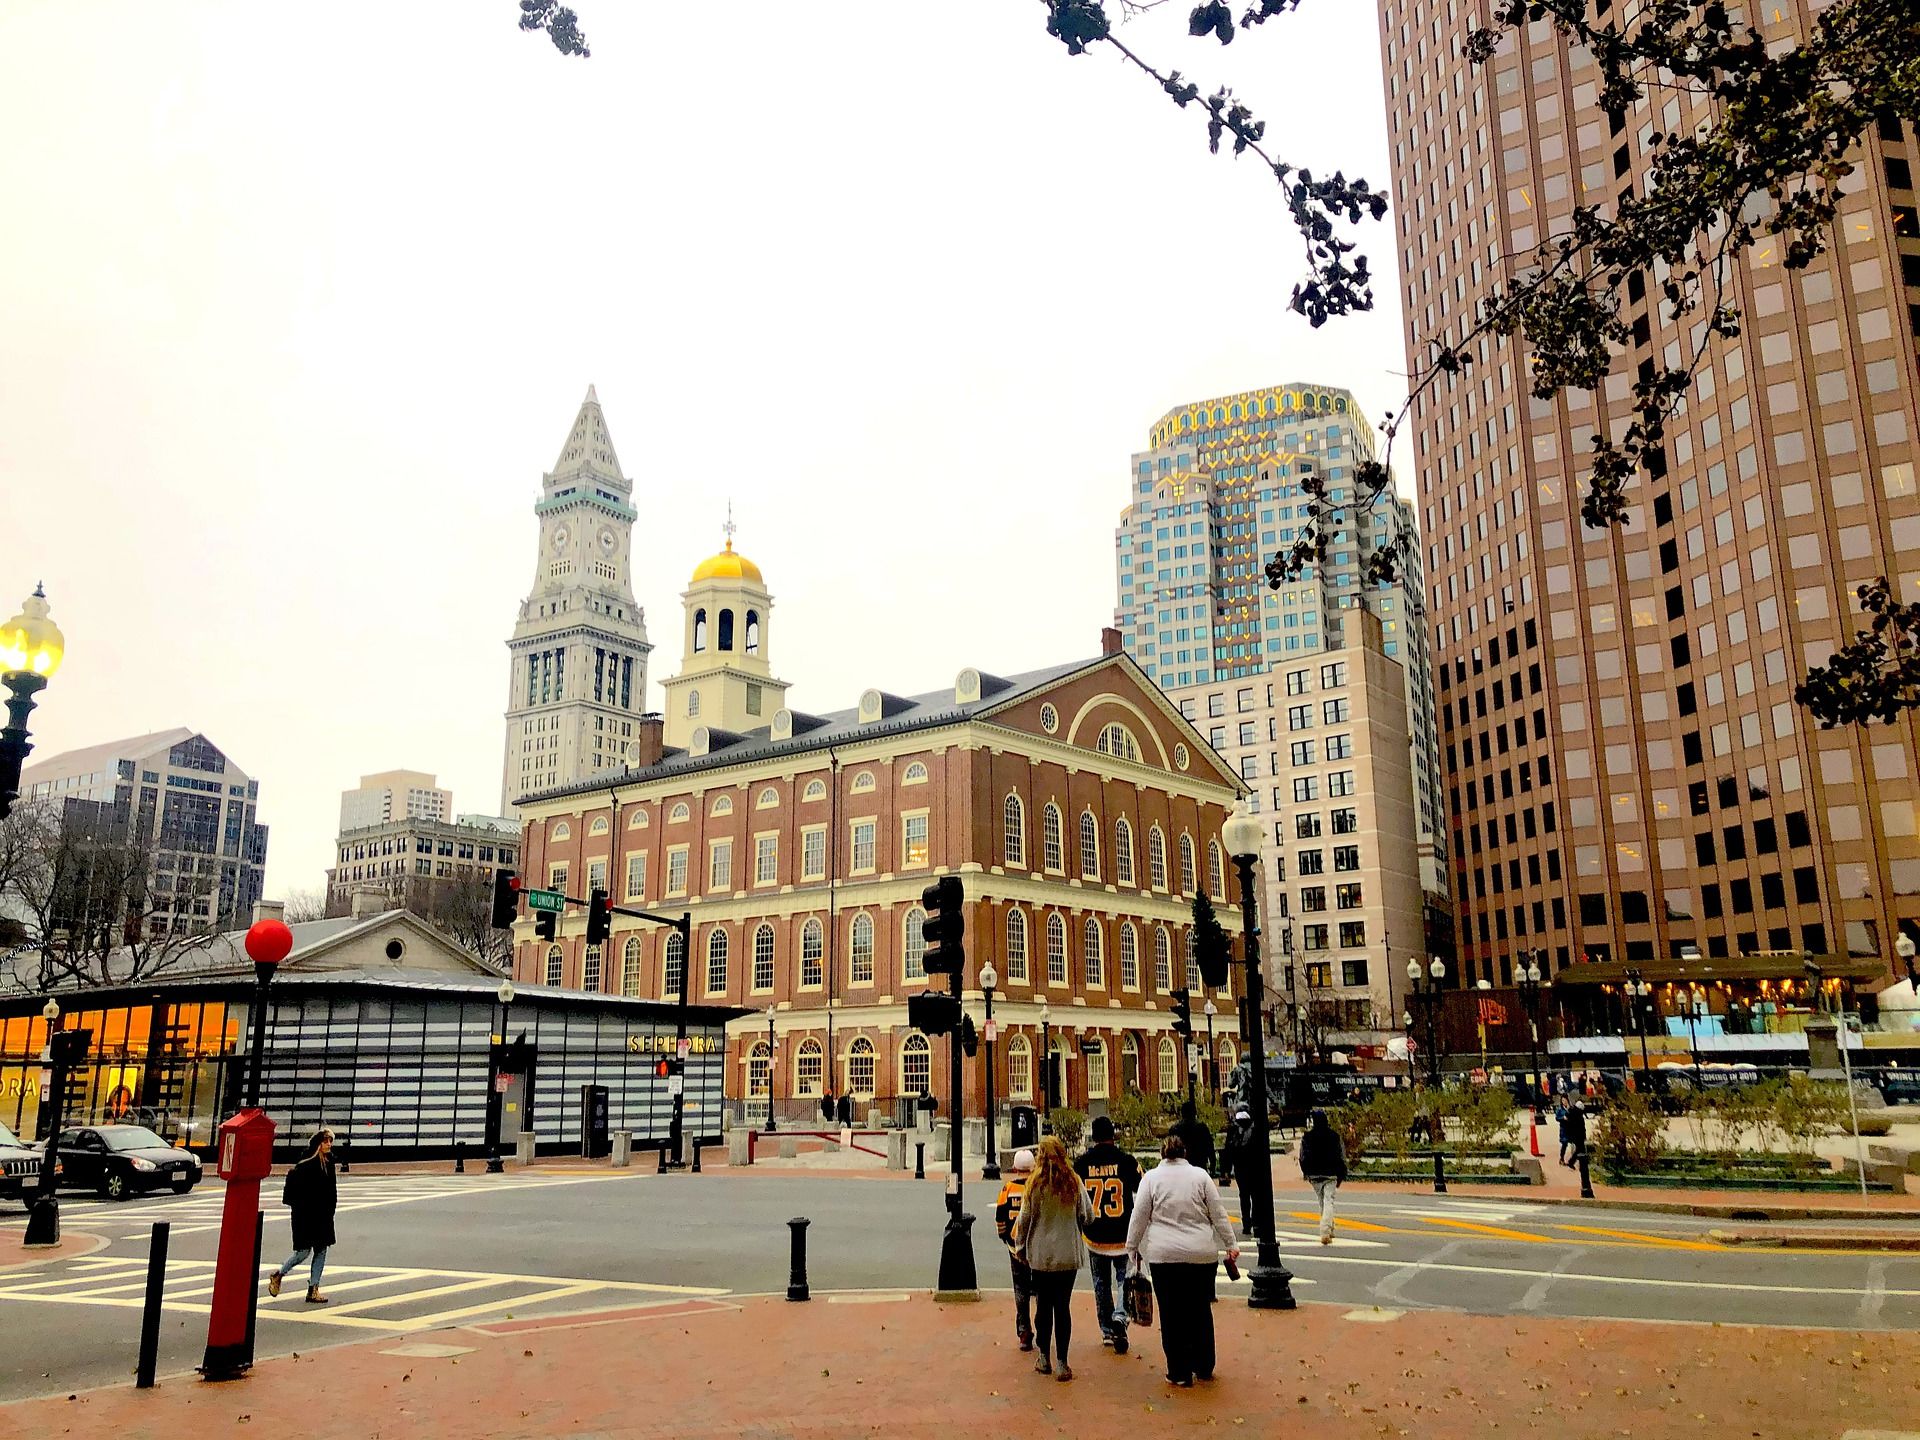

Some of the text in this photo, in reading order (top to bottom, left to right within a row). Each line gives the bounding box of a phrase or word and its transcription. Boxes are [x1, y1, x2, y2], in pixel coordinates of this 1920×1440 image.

[537, 894, 564, 909] UNION ST
[1088, 1164, 1118, 1177] McAVOY
[1085, 1178, 1124, 1218] 73
